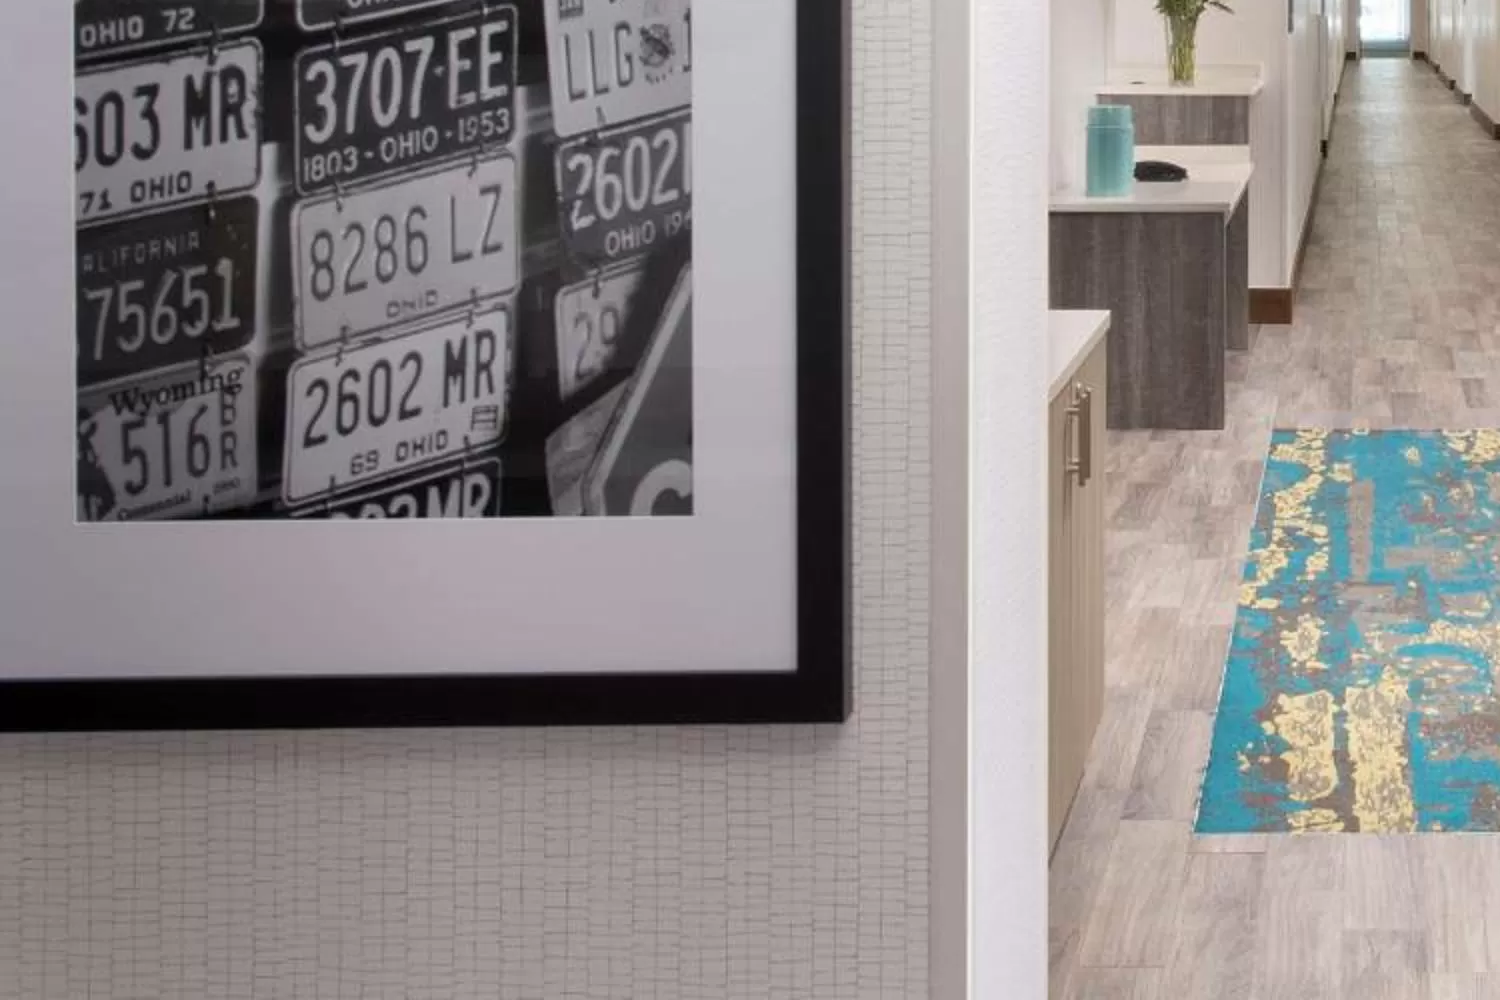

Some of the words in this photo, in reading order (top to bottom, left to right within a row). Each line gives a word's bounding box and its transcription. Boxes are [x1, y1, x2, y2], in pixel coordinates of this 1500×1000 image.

[80, 15, 144, 47] OHIO
[161, 7, 195, 32] 72
[564, 21, 634, 101] LLG
[184, 65, 248, 151] MR
[305, 36, 434, 144] 3707
[449, 20, 508, 109] EE
[304, 146, 358, 182] 1803
[380, 126, 439, 163] OHIO
[458, 108, 510, 143] 1953
[567, 128, 679, 231] 2602
[80, 188, 112, 213] 71
[131, 170, 192, 203] OHIO
[311, 205, 428, 301] 8286
[451, 184, 503, 263] LZ
[604, 220, 656, 257] OHIO
[83, 257, 240, 360] 75651
[387, 289, 438, 318] OHIO
[109, 366, 244, 417] Wyoming
[303, 351, 422, 448] 2602
[442, 329, 496, 408] MR
[121, 403, 210, 496] 516
[351, 450, 378, 475] 69
[395, 429, 448, 462] OHIO
